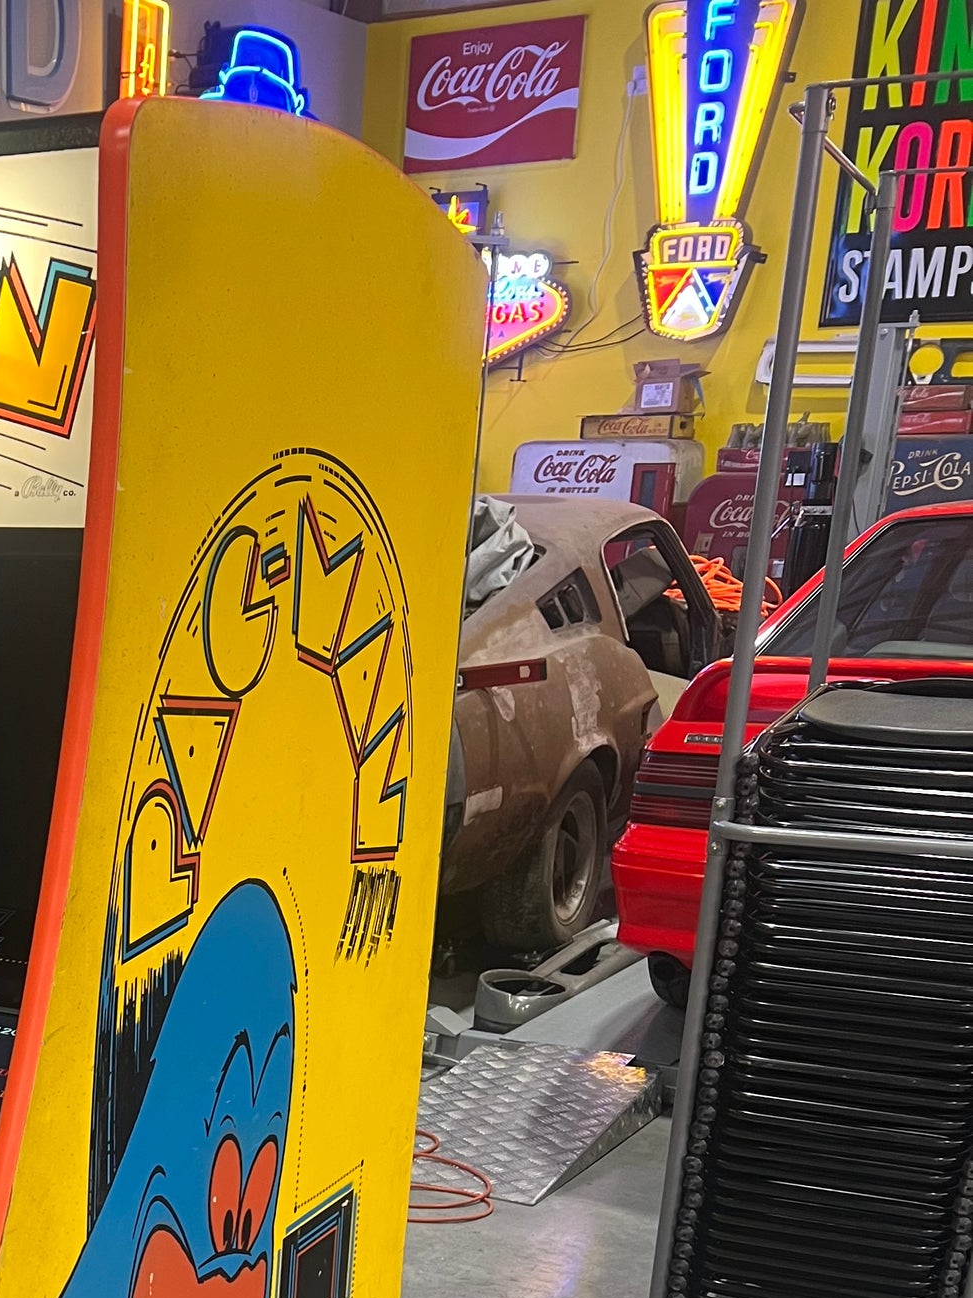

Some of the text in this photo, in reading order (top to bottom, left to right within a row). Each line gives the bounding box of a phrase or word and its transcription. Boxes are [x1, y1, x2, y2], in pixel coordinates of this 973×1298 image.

[462, 41, 493, 56] Enjoy
[417, 39, 570, 111] Coca-Cola
[688, 0, 740, 196] FORD
[846, 120, 973, 234] KOR
[662, 234, 731, 264] FORD
[533, 453, 622, 485] Coca-Cola
[908, 449, 938, 459] DRINK
[559, 486, 600, 494] BOTTLES
[122, 490, 408, 964] PAC-MAN
